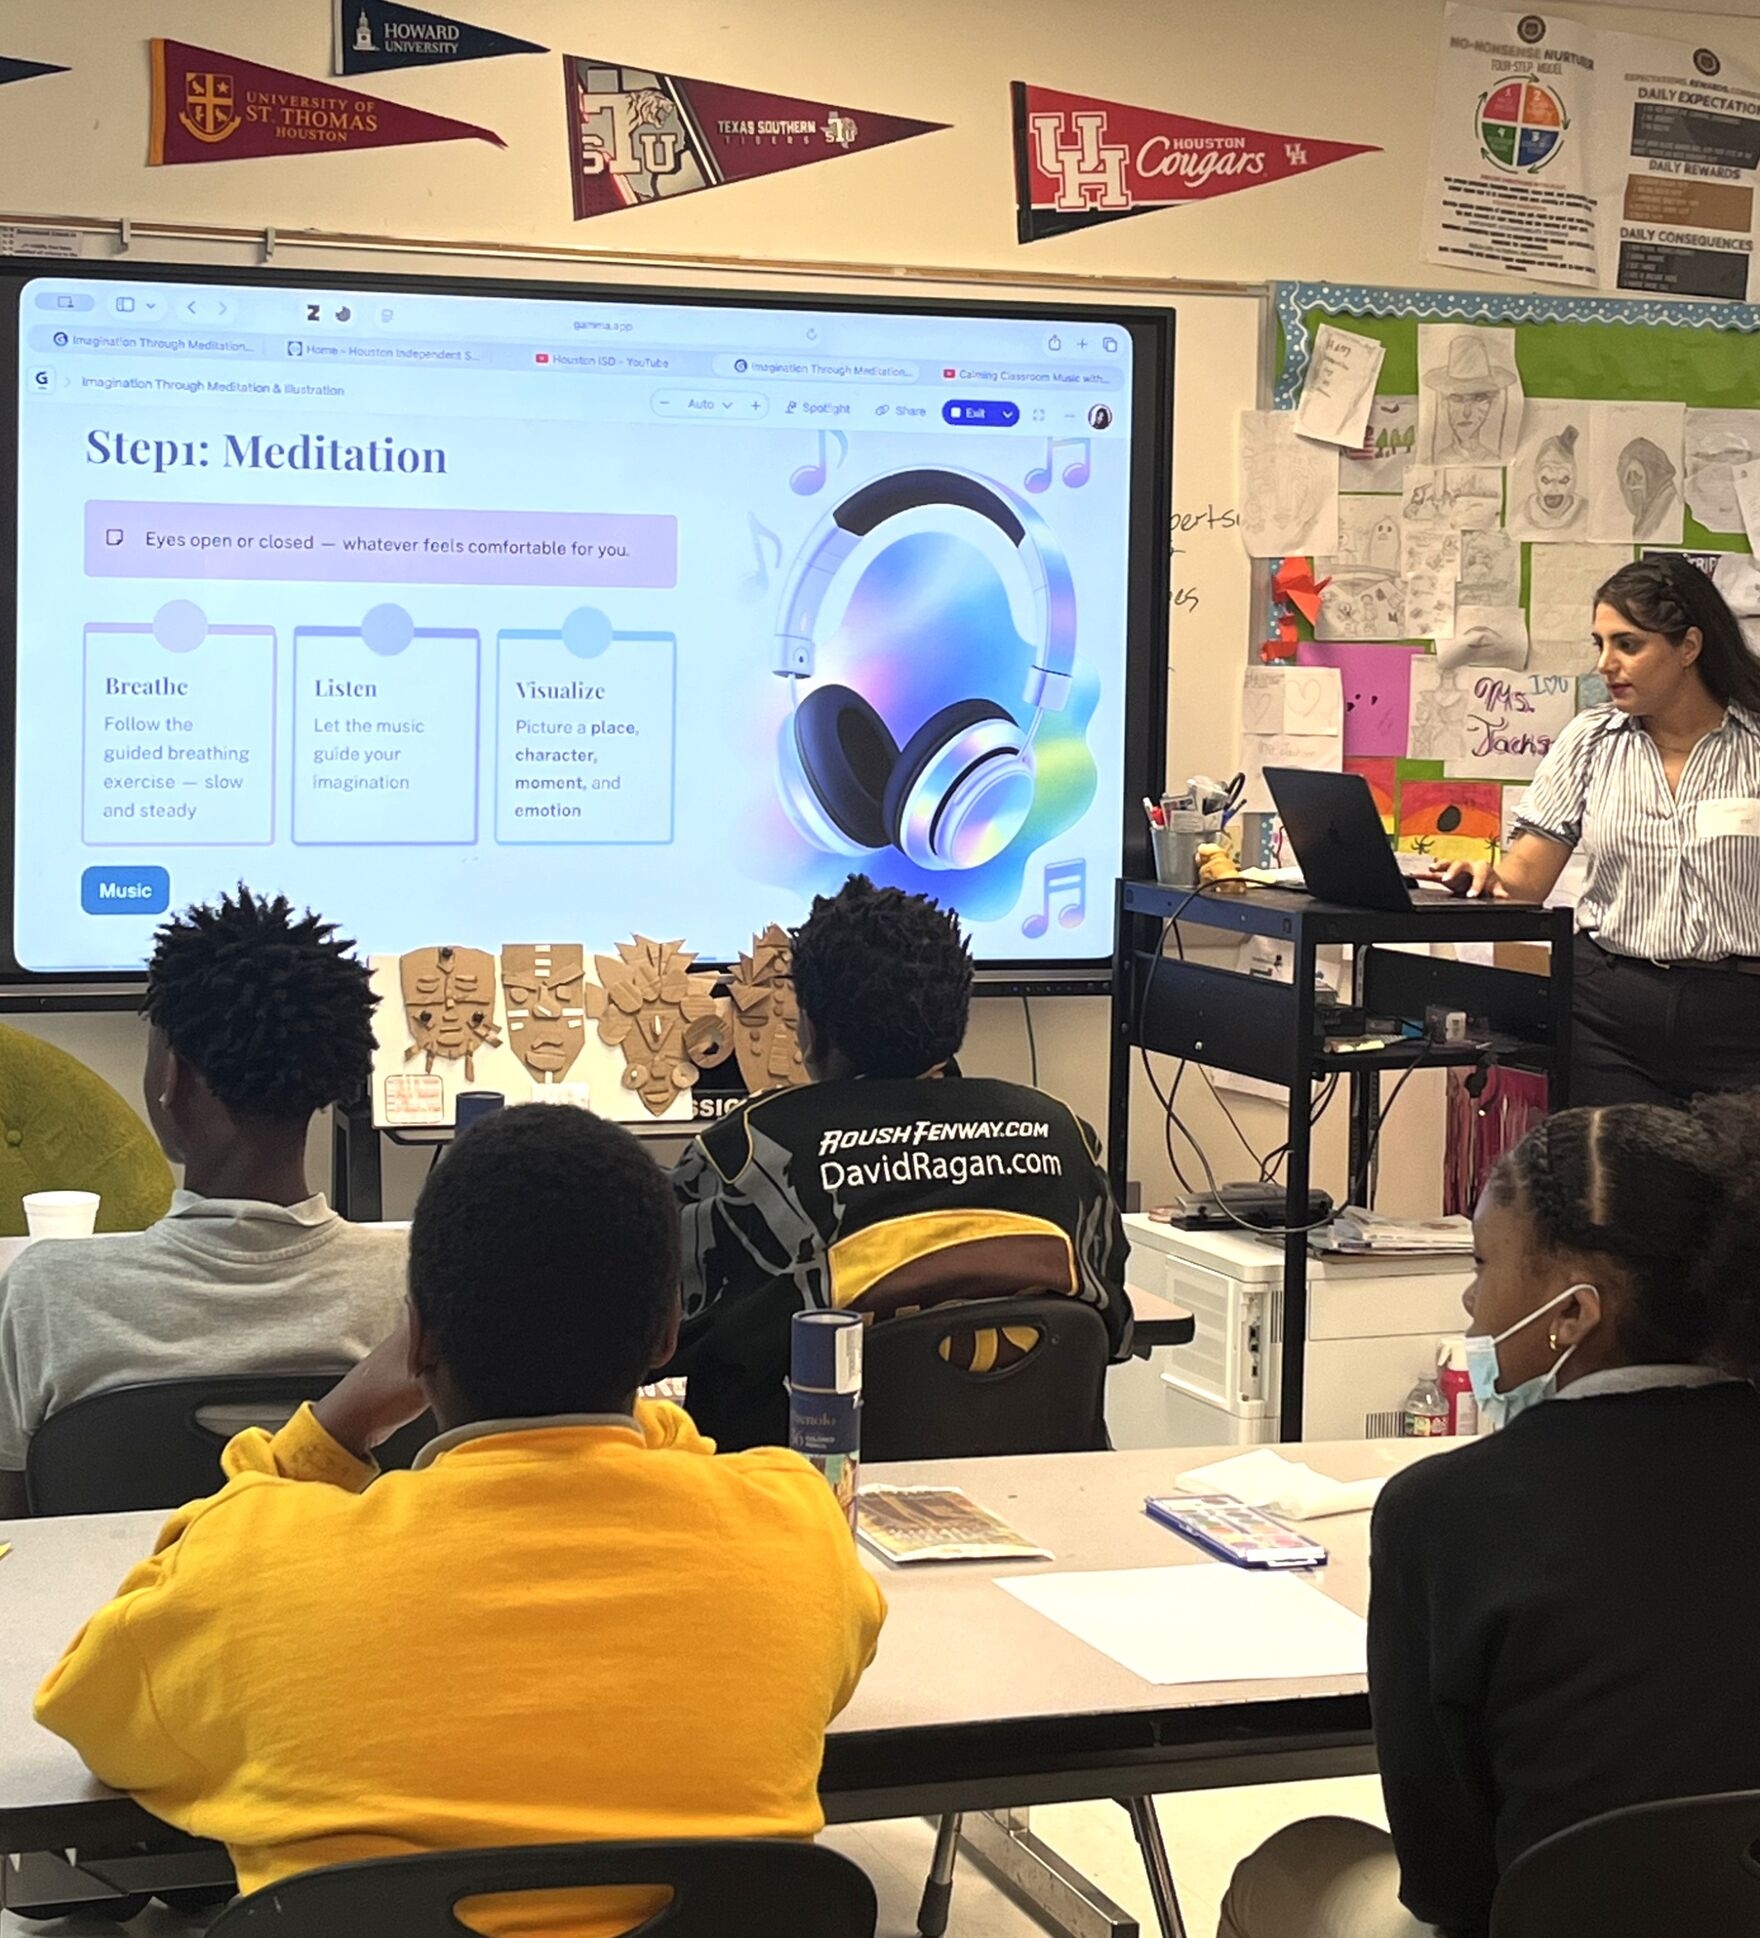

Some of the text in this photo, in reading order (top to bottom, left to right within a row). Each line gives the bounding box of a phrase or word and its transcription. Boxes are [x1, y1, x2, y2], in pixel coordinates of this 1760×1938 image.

[384, 22, 460, 41] HOWARD
[384, 40, 459, 54] UNIVERSITY
[246, 91, 376, 113] UNIVERSITY OF
[1638, 87, 1677, 102] DAILY
[280, 107, 378, 132] THOMAS
[718, 120, 816, 134] TEXAS SOUTHERN
[275, 127, 348, 142] HOUSTON
[1173, 137, 1246, 150] HOUSTON
[1136, 136, 1265, 188] Cougars
[1649, 160, 1741, 179] DAILY REWARDS
[1620, 226, 1753, 252] DAILY CONSEQUENCES
[73, 335, 137, 349] Imagination
[140, 337, 185, 350] Through
[307, 345, 338, 356] Home
[349, 346, 393, 358] Houston
[396, 348, 461, 361] Independent
[553, 354, 595, 366] Houston
[598, 356, 616, 367] ISD
[627, 357, 669, 369] YouTube
[751, 361, 808, 375] Imagination
[812, 364, 850, 377] Through
[1000, 371, 1050, 382] Classroom
[1053, 373, 1080, 383] Music
[82, 376, 345, 396] Imagination Through Meditation & Illustration
[688, 398, 714, 410] Auto
[803, 402, 850, 416] Spotlight
[895, 405, 926, 416] Share
[966, 407, 986, 419] Exit
[86, 428, 447, 475] Step1: Meditation
[146, 531, 186, 550] Eyes
[190, 534, 232, 552] open
[237, 536, 254, 549] or
[258, 534, 314, 551] closed
[343, 536, 418, 553] whatever
[423, 537, 464, 554] feels
[468, 539, 567, 556] comfortable
[571, 541, 593, 557] for
[598, 544, 630, 559] you.
[105, 677, 189, 697] Breathe
[315, 678, 378, 698] Listen
[516, 681, 606, 700] Visualize
[104, 716, 193, 732] Follow the
[313, 718, 425, 733] Let the music
[516, 719, 640, 737] Picture a place,
[104, 745, 250, 763] guided breathing
[313, 746, 401, 763] guide your
[515, 748, 598, 764] character,
[103, 775, 176, 790] exercise
[204, 774, 243, 790] slow
[312, 775, 410, 792] imagination
[515, 776, 621, 791] moment, and
[103, 802, 197, 820] and steady
[515, 803, 582, 818] emotion
[99, 881, 153, 901] Music
[820, 1151, 1063, 1190] DavidRagan.com
